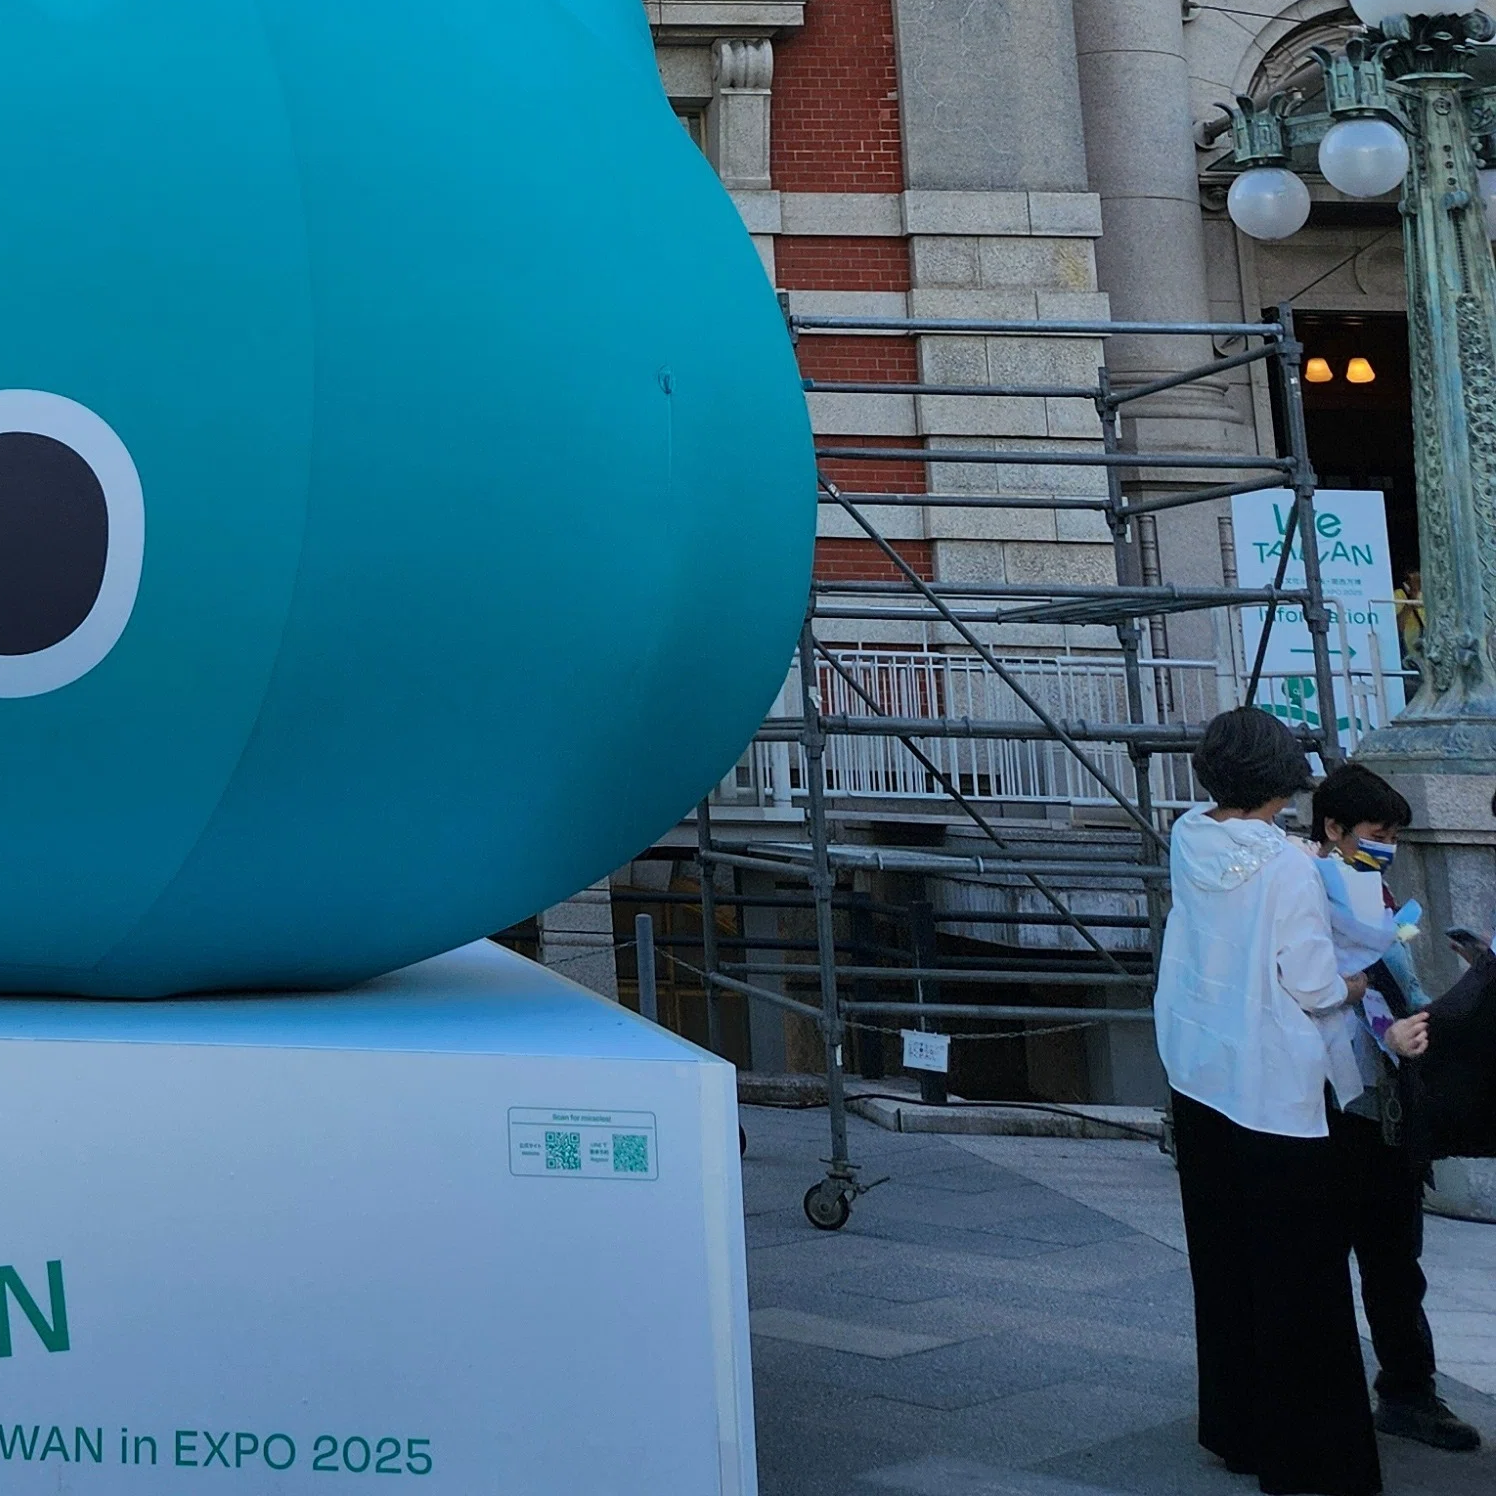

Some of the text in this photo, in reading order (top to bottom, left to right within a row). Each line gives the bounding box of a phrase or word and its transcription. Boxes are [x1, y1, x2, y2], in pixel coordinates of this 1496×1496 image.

[121, 1427, 157, 1465] in
[175, 1430, 296, 1470] EXPO
[312, 1435, 433, 1475] 2025
